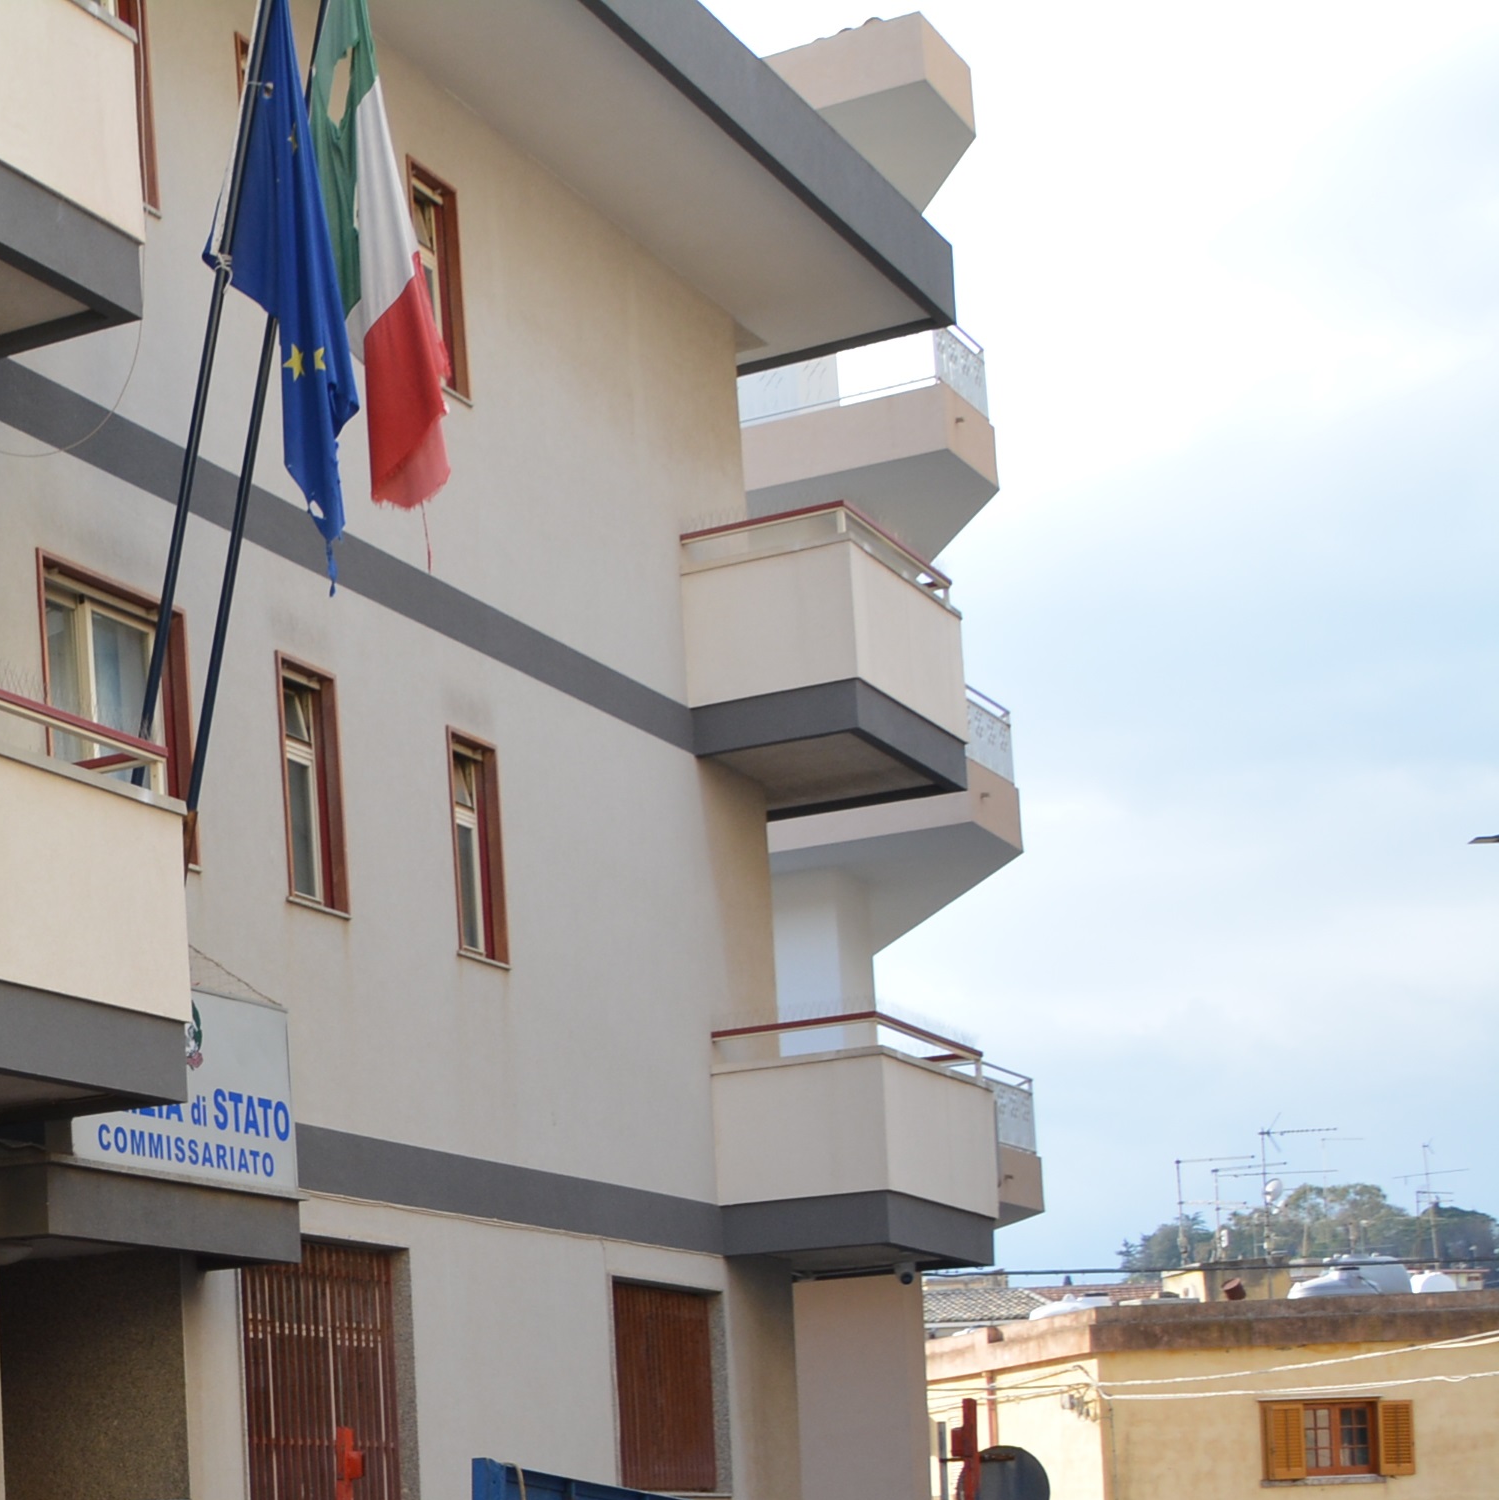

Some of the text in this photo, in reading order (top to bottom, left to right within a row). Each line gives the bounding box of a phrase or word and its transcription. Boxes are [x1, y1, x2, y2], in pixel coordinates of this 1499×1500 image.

[191, 1095, 207, 1127] di
[213, 1088, 290, 1142] STATO
[98, 1123, 274, 1177] COMMISSARIATO
